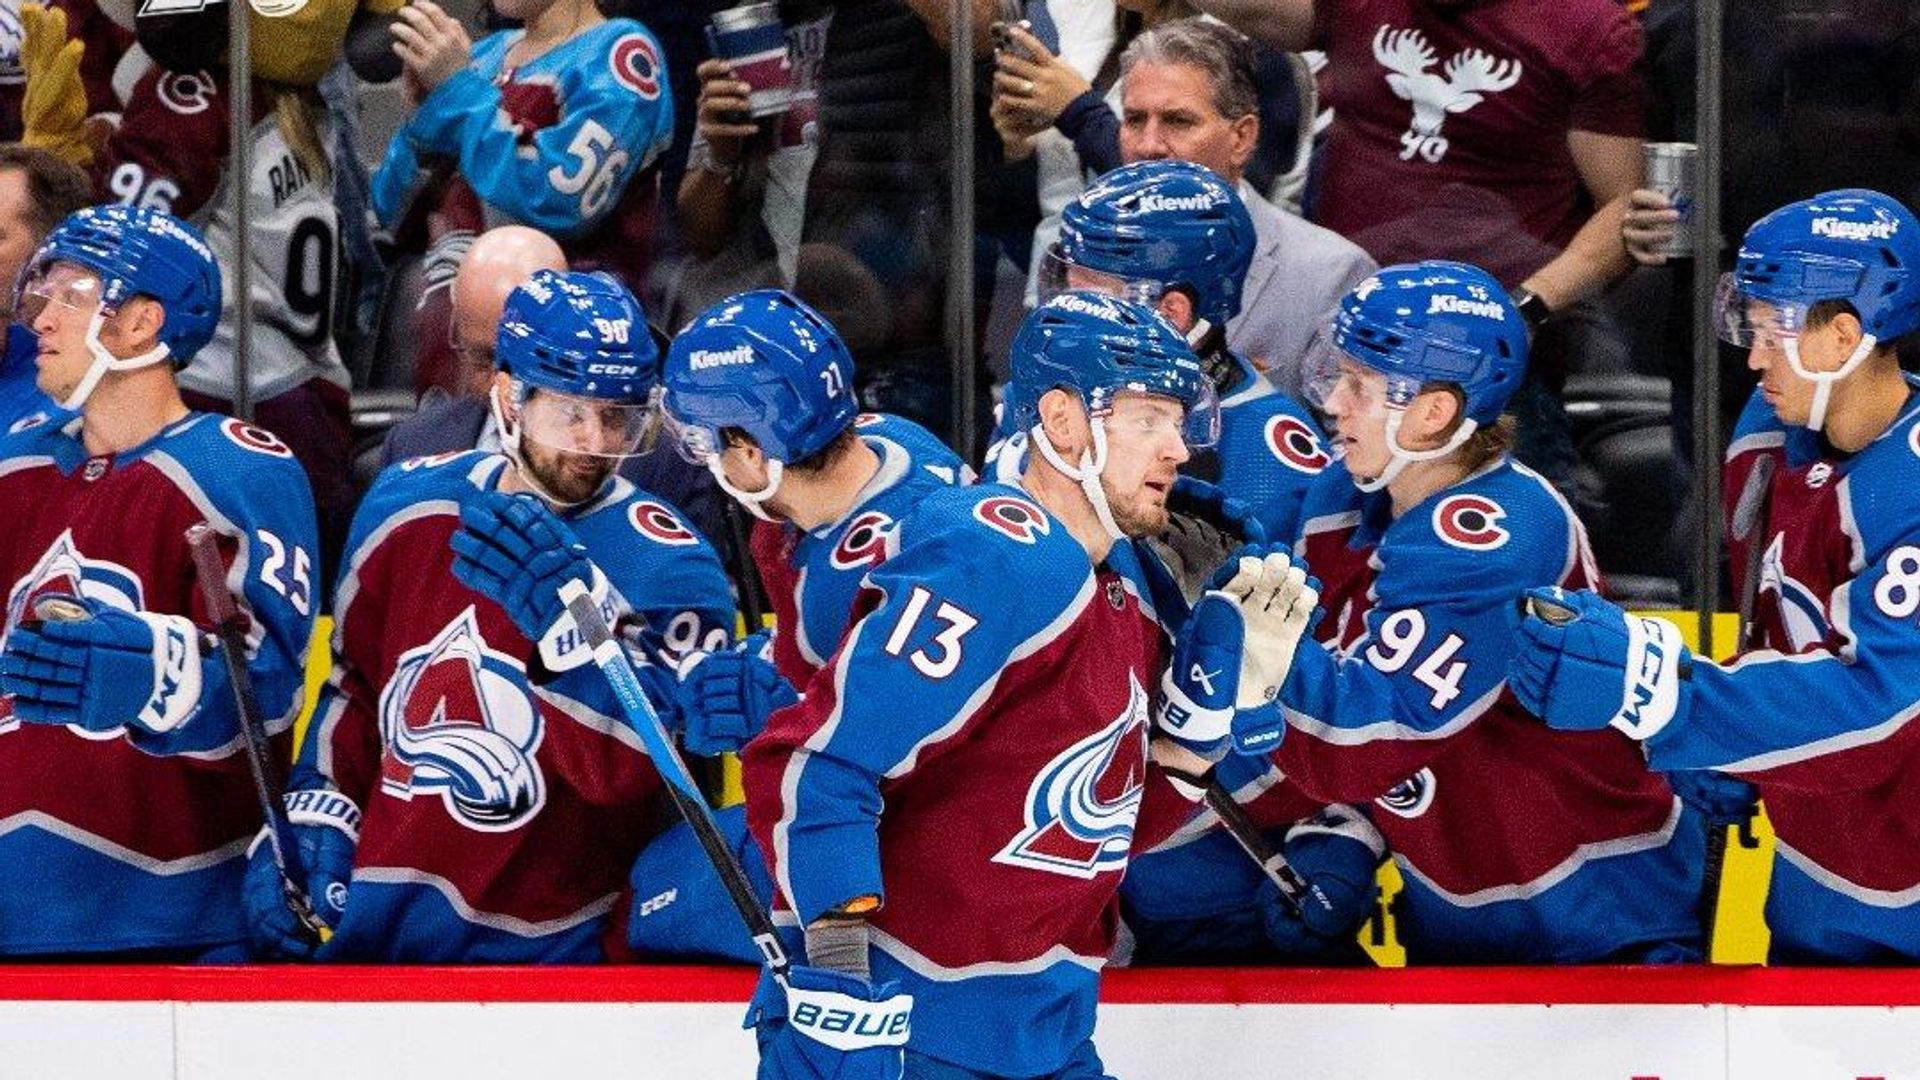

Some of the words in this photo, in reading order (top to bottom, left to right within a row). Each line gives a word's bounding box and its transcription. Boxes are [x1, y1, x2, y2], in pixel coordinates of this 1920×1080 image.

[111, 163, 181, 216] 96
[549, 118, 629, 219] 56
[1139, 193, 1213, 212] Kiewit
[594, 318, 632, 344] 90
[1428, 294, 1505, 321] Kiewit
[587, 363, 638, 375] CCM
[689, 344, 755, 371] Kiewit
[819, 361, 844, 399] 27
[258, 529, 311, 616] 25
[885, 586, 978, 679] 13
[1366, 608, 1469, 710] 94
[151, 619, 187, 719] CM
[1622, 618, 1664, 727] CCM
